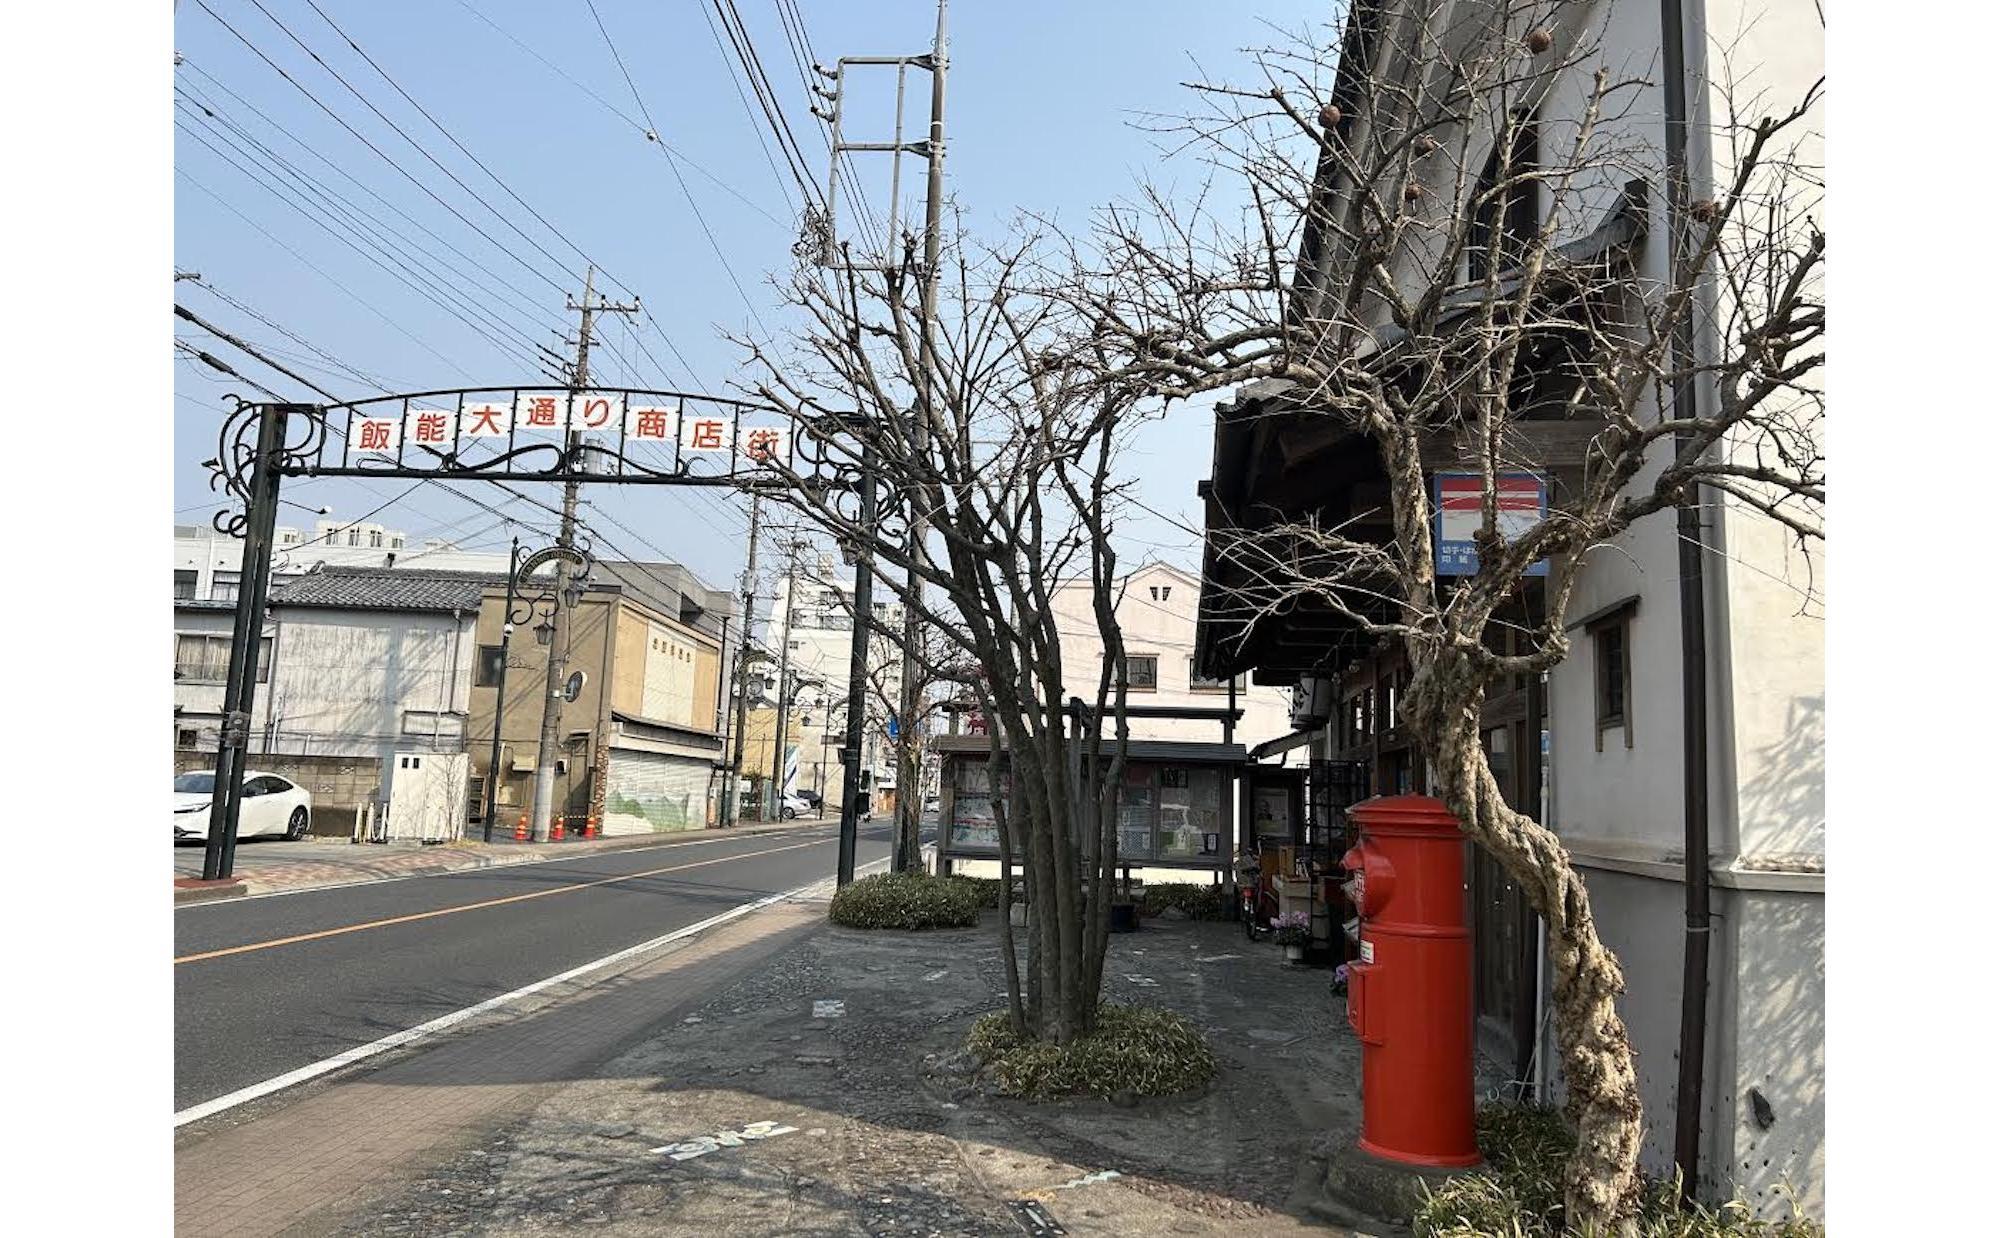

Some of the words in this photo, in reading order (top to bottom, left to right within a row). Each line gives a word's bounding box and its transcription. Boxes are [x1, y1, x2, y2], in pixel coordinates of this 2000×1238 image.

[359, 397, 779, 461] 飯能大通り商店街
